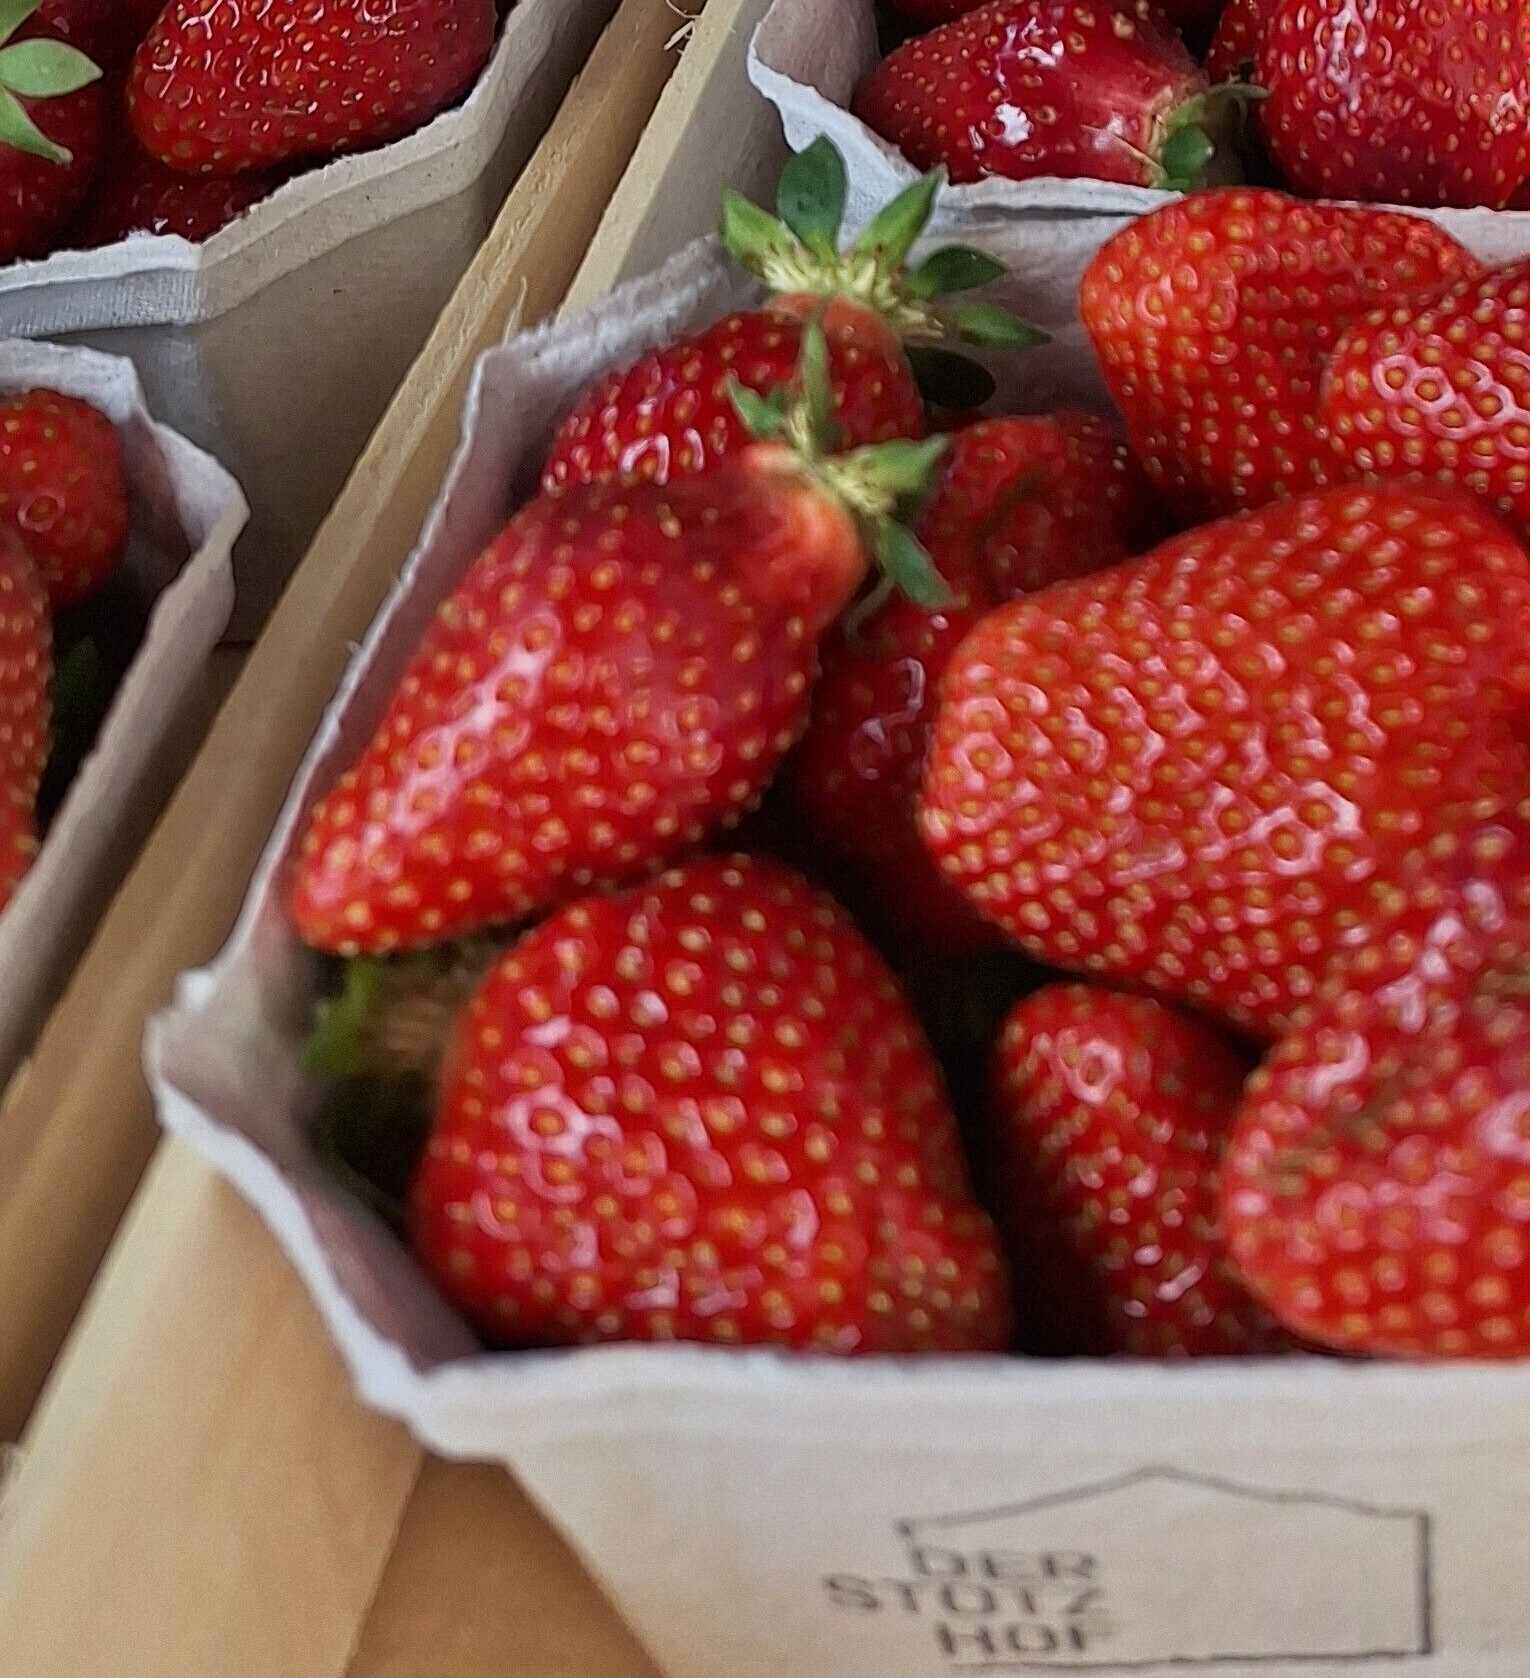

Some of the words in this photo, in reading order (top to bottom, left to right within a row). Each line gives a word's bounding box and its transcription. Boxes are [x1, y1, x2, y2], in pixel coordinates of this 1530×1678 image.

[908, 1544, 1097, 1576] DER
[824, 1572, 1104, 1616] STOTZ
[936, 1620, 1115, 1656] HOF
